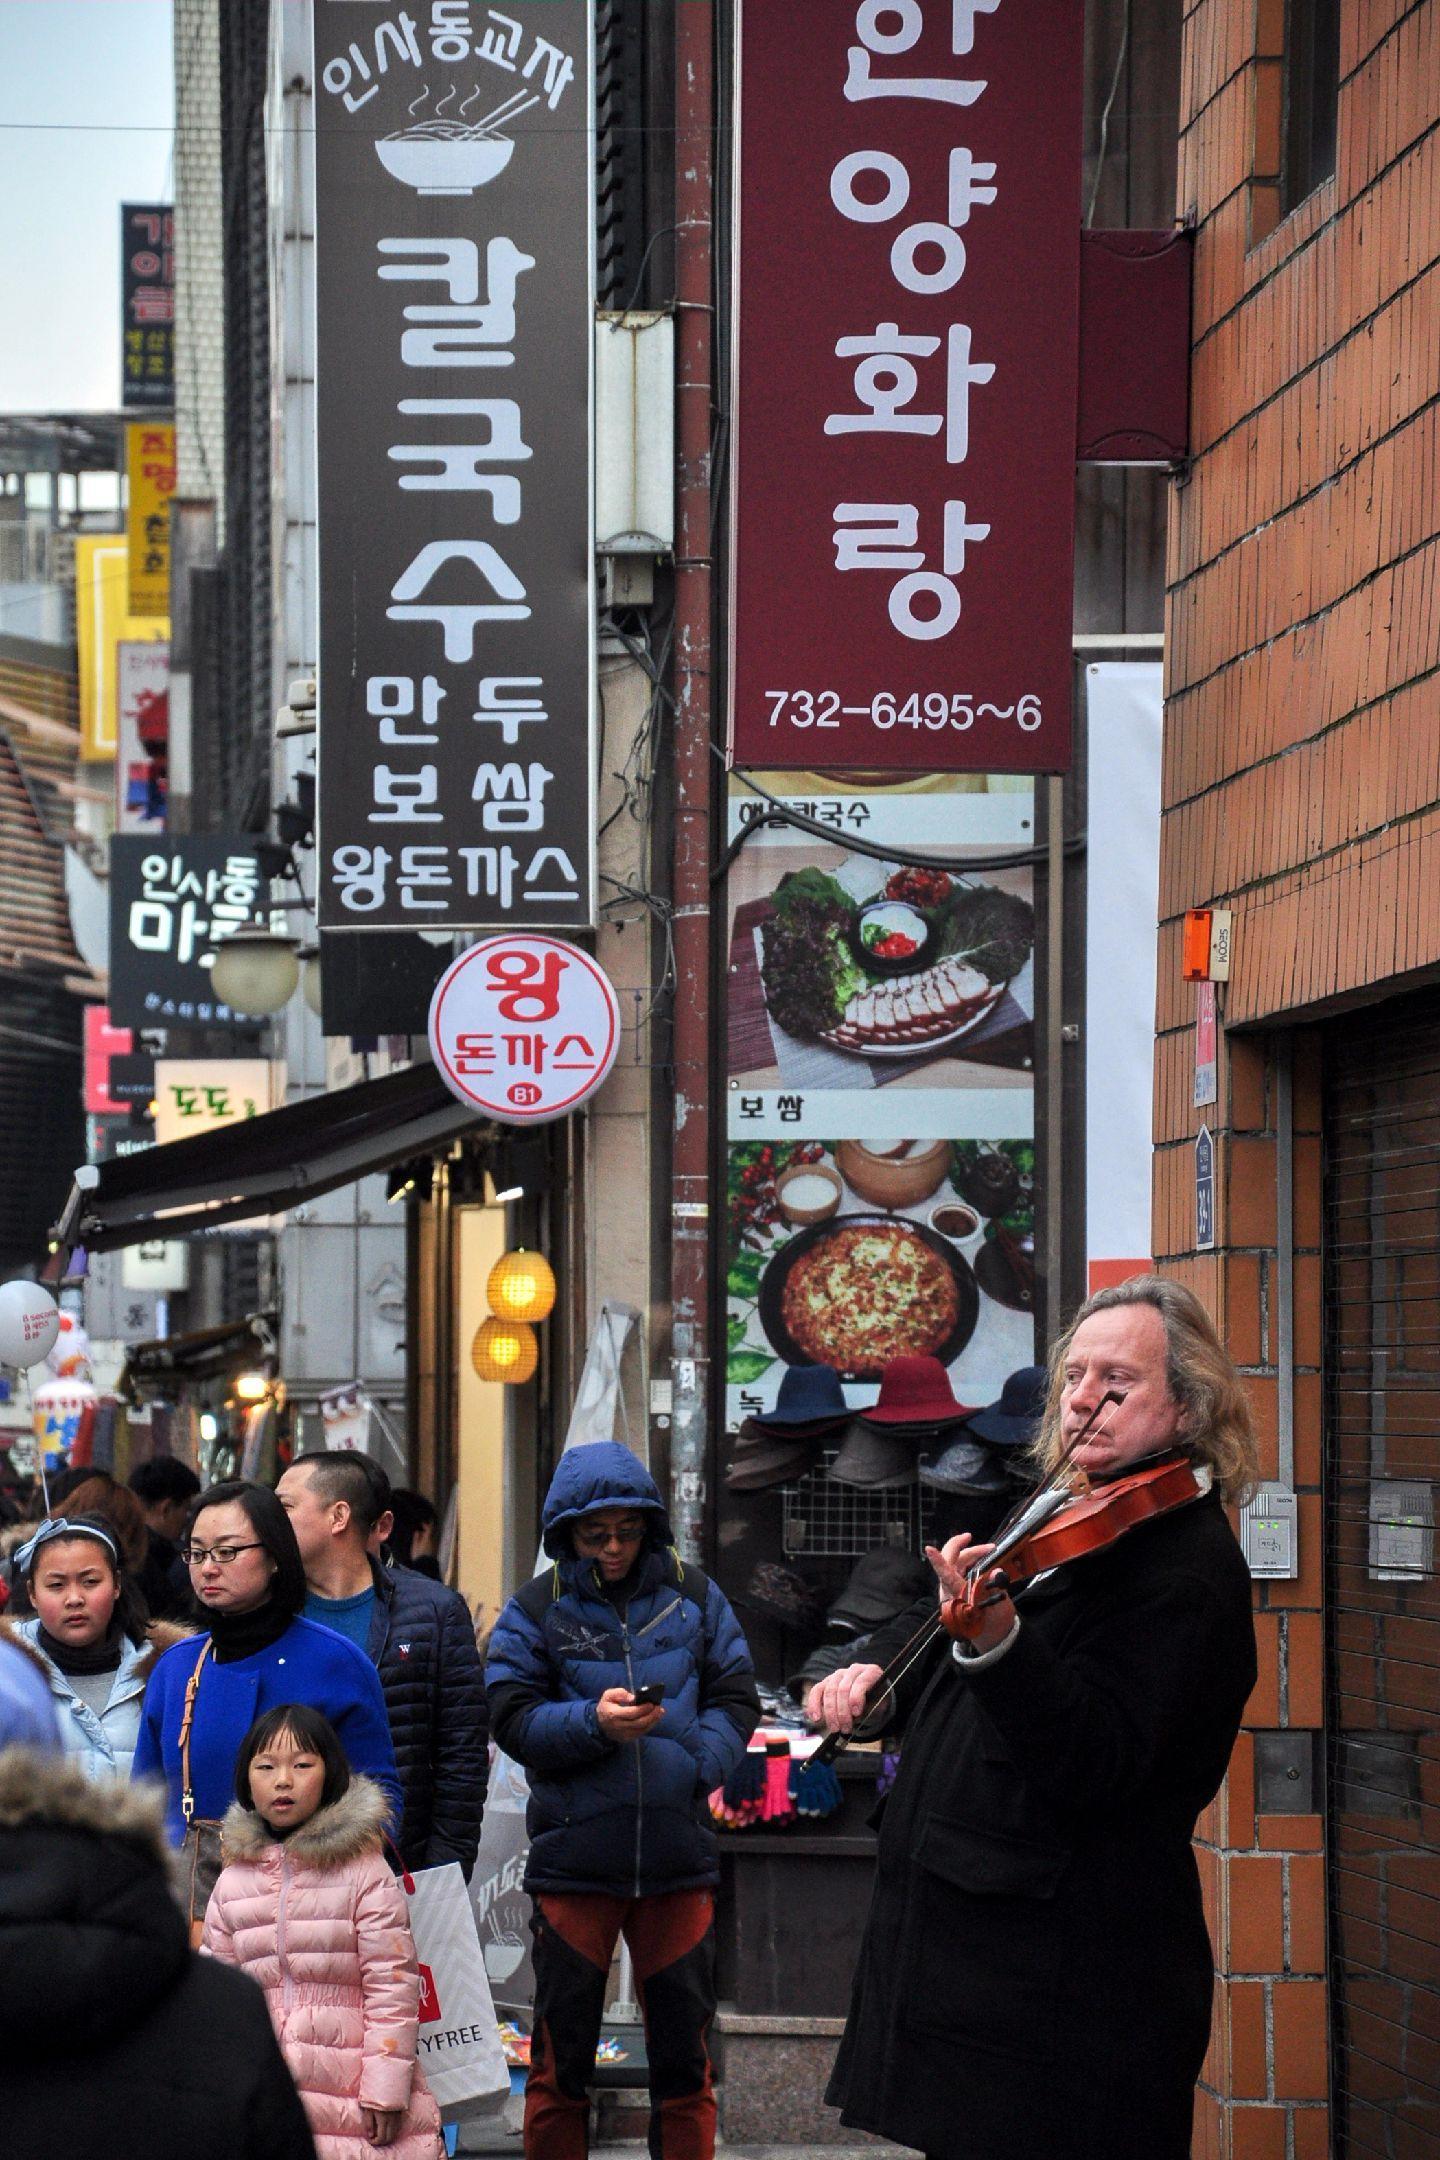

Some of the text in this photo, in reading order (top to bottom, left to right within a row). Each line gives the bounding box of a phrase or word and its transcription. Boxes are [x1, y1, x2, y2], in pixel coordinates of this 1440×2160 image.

[322, 1, 574, 113] 인사동교자
[377, 236, 536, 663] 칼국수
[140, 854, 260, 906] 인사동
[332, 845, 580, 911] 왕돈까스
[1218, 928, 1229, 963] SECOM
[486, 950, 571, 1023] 왕
[453, 1034, 596, 1075] 돈까스
[514, 1087, 536, 1101] B1
